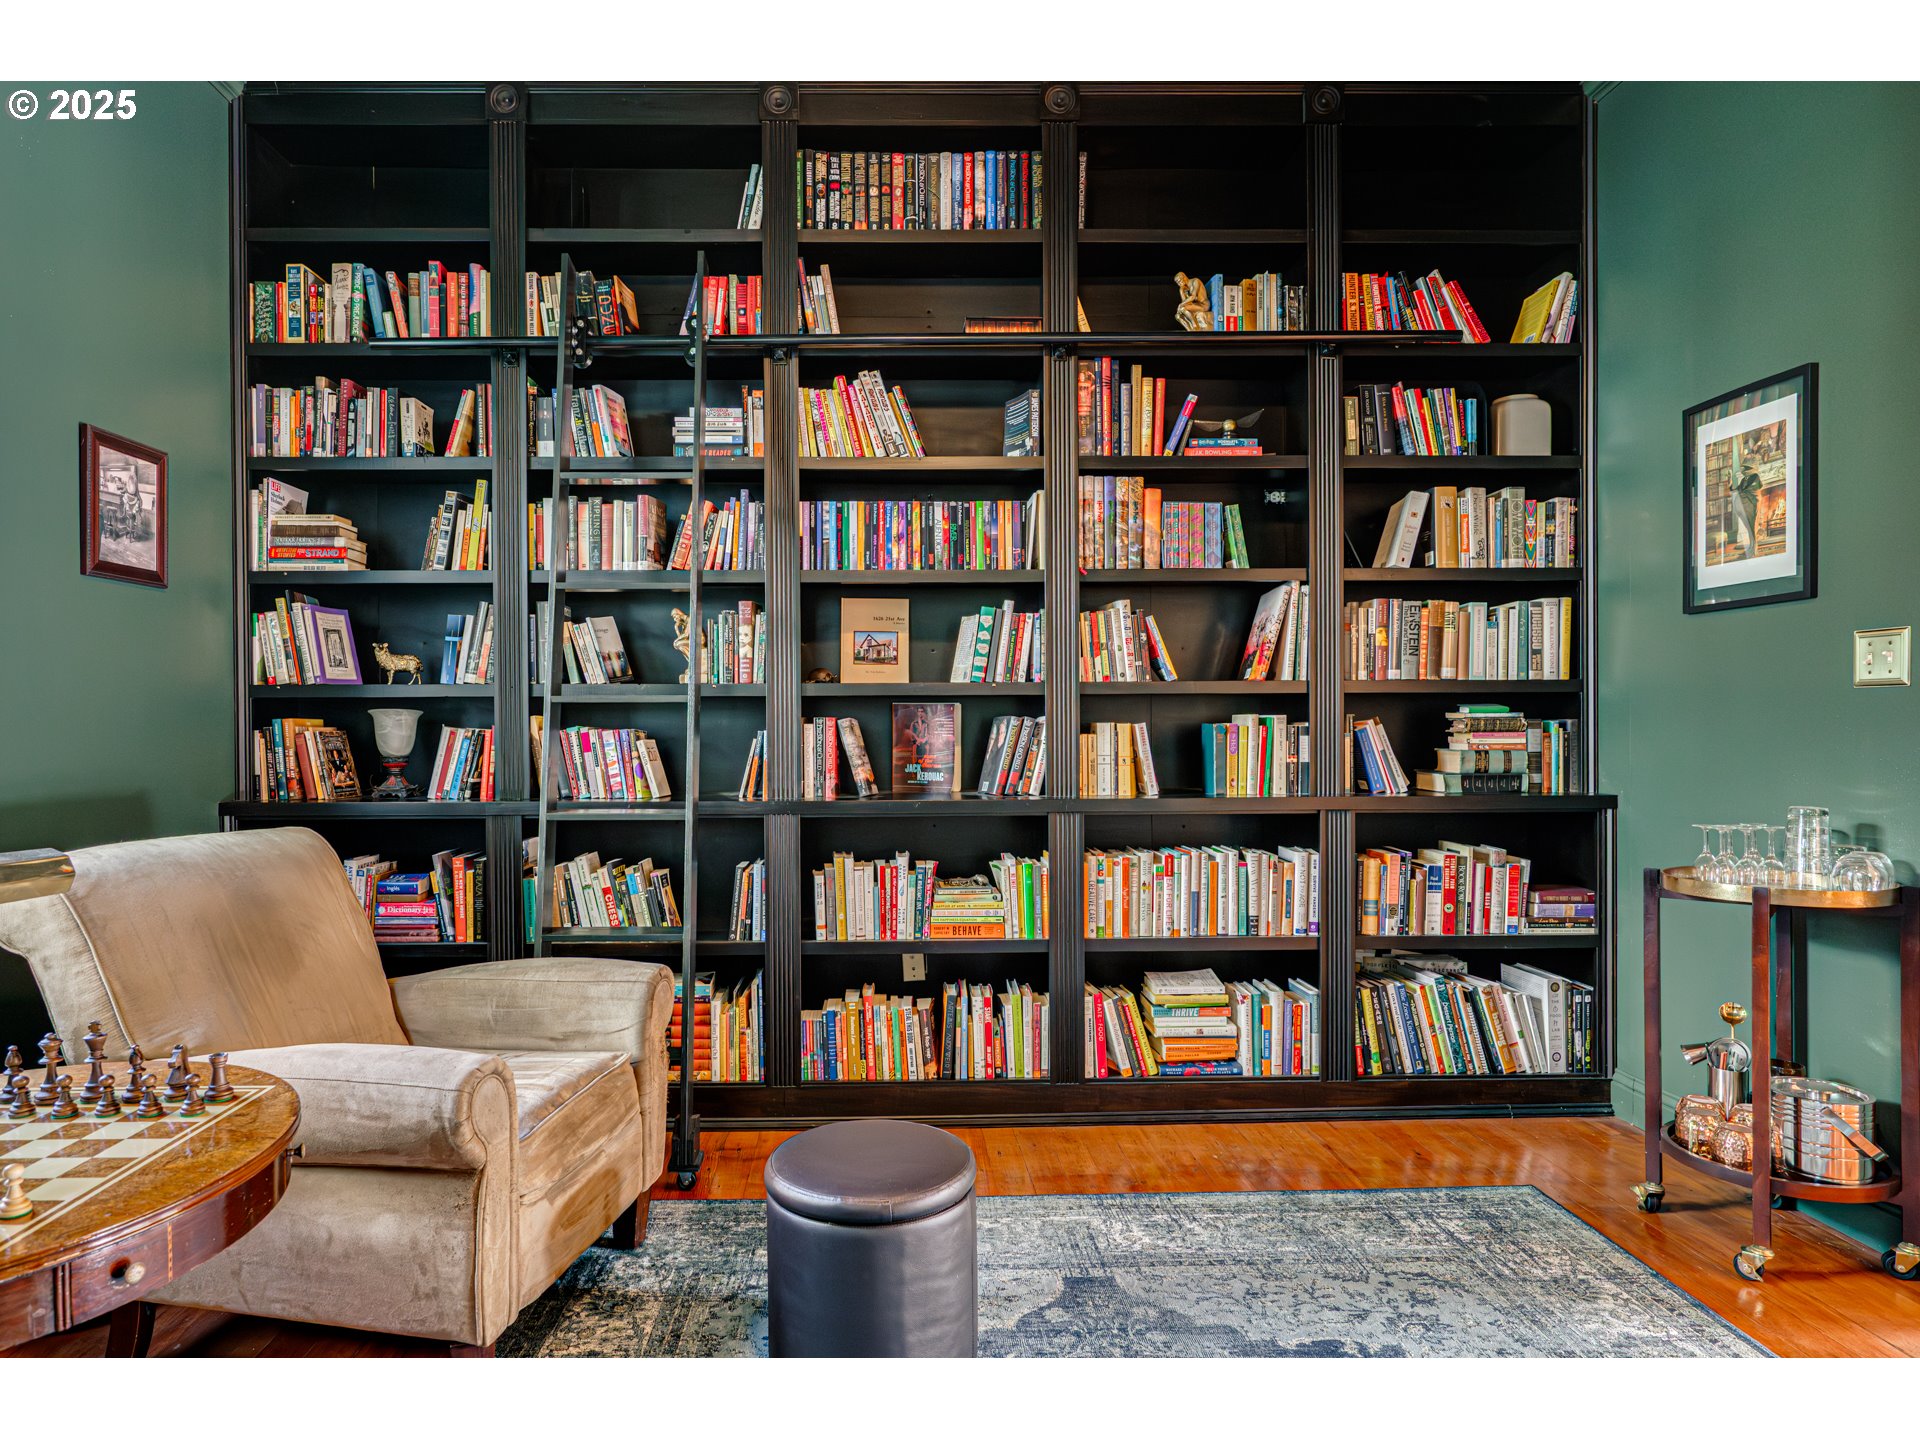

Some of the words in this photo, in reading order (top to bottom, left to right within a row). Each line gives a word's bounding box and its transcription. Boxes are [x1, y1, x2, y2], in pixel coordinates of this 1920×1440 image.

[353, 272, 361, 290] PRIDE
[1348, 274, 1357, 300] HUNTER
[1372, 284, 1380, 305] HUNTER
[352, 303, 360, 335] PREJUDICE
[1031, 411, 1039, 437] PATTERSON
[1205, 449, 1232, 457] ROWLING
[271, 481, 281, 493] LIFE
[593, 499, 601, 535] KIPLING
[305, 549, 340, 557] STRAND
[916, 771, 944, 781] KEROUAC
[1250, 855, 1258, 876] How
[475, 875, 483, 896] PLAZA
[1088, 880, 1096, 908] CREATIVE
[1165, 878, 1173, 892] EAT
[1251, 878, 1257, 894] We
[604, 894, 619, 926] CHESS
[1165, 893, 1173, 908] FOR
[1088, 909, 1096, 924] CARE
[952, 925, 982, 936] BEHAVE
[904, 1008, 912, 1022] STEAL
[1171, 1007, 1199, 1017] THRIVE
[1441, 1001, 1452, 1023] Dessert
[905, 1022, 913, 1032] THIS
[1401, 1002, 1411, 1020] Zones
[1406, 1020, 1416, 1044] Kitchen
[1491, 1012, 1506, 1048] baking
[1446, 1023, 1456, 1043] Person
